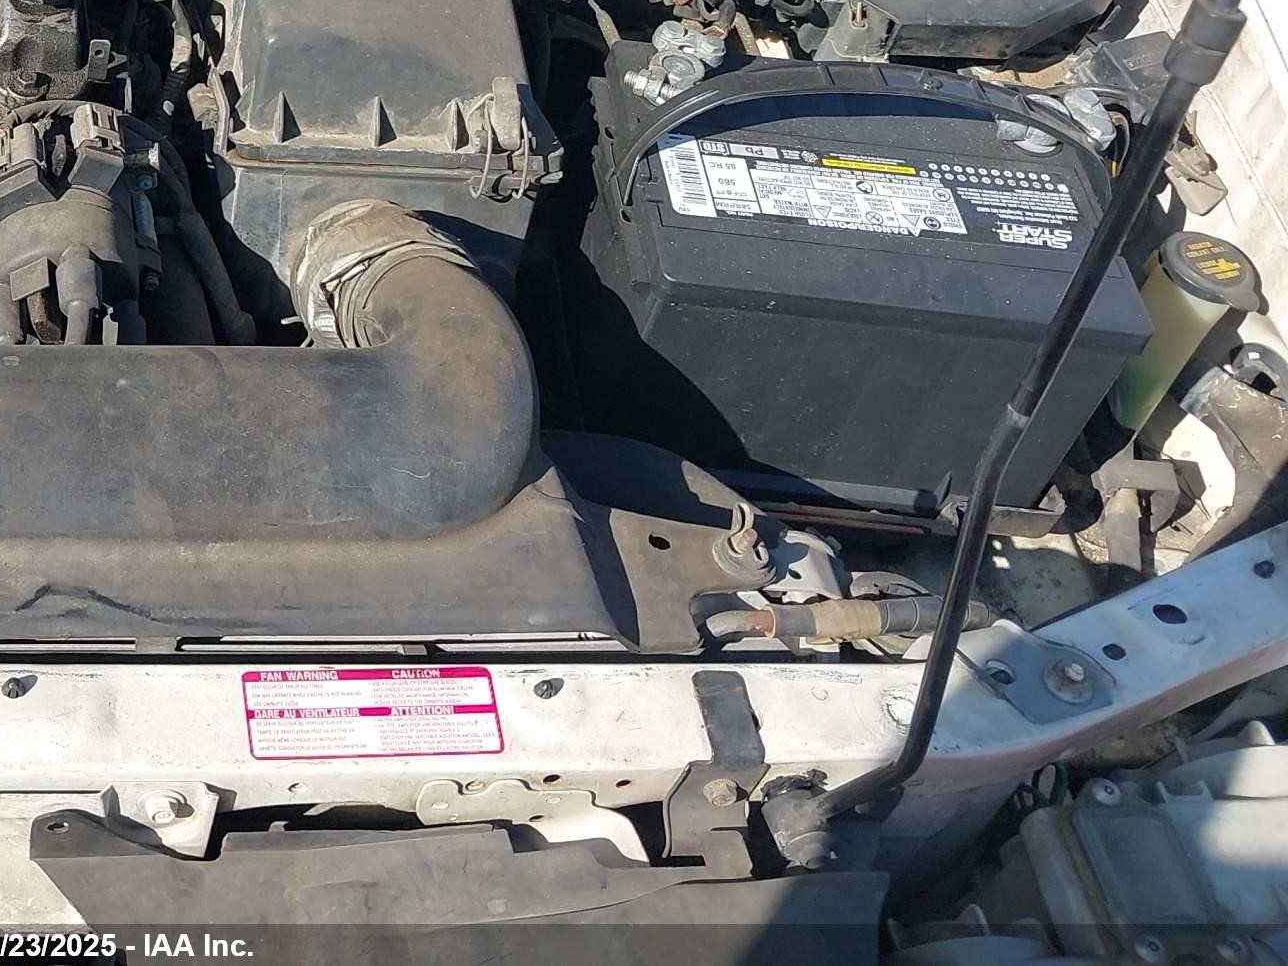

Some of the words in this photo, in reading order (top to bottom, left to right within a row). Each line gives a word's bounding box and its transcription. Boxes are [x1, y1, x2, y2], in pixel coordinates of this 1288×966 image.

[745, 147, 764, 155] Pb
[718, 178, 736, 186] 580
[808, 219, 909, 234] DANGER/POISON
[999, 224, 1072, 242] START
[999, 233, 1068, 249] SUPER
[259, 671, 284, 681] FAN
[286, 670, 338, 681] WARNING
[391, 669, 440, 679] CAUTION
[254, 709, 280, 719] GARE
[282, 708, 296, 718] AU
[299, 707, 360, 718] VENTILATEUR
[390, 705, 454, 716] ATTENTION!
